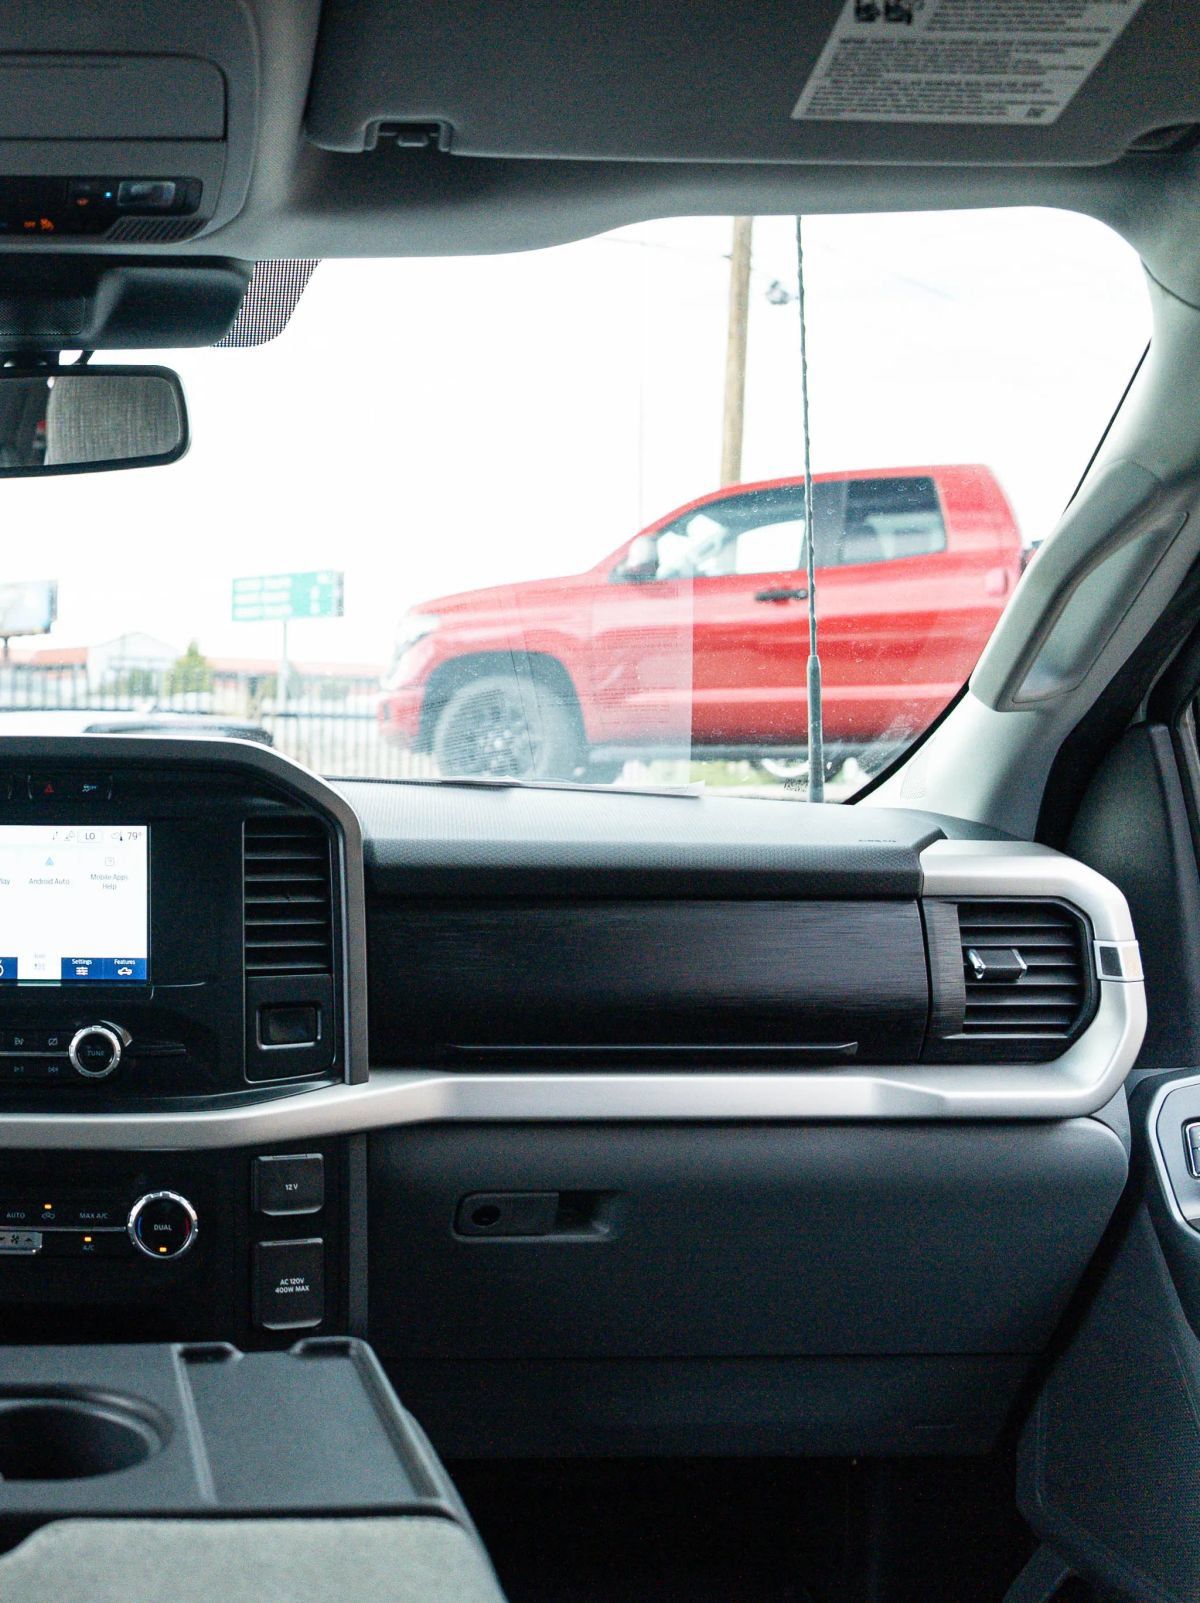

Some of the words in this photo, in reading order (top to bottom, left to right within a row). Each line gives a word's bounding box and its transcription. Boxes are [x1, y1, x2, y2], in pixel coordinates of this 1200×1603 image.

[84, 832, 96, 841] LO
[28, 877, 51, 885] Android
[52, 878, 70, 886] Auto
[90, 873, 111, 881] Mobile
[112, 874, 128, 882] Apps
[102, 882, 117, 891] Help
